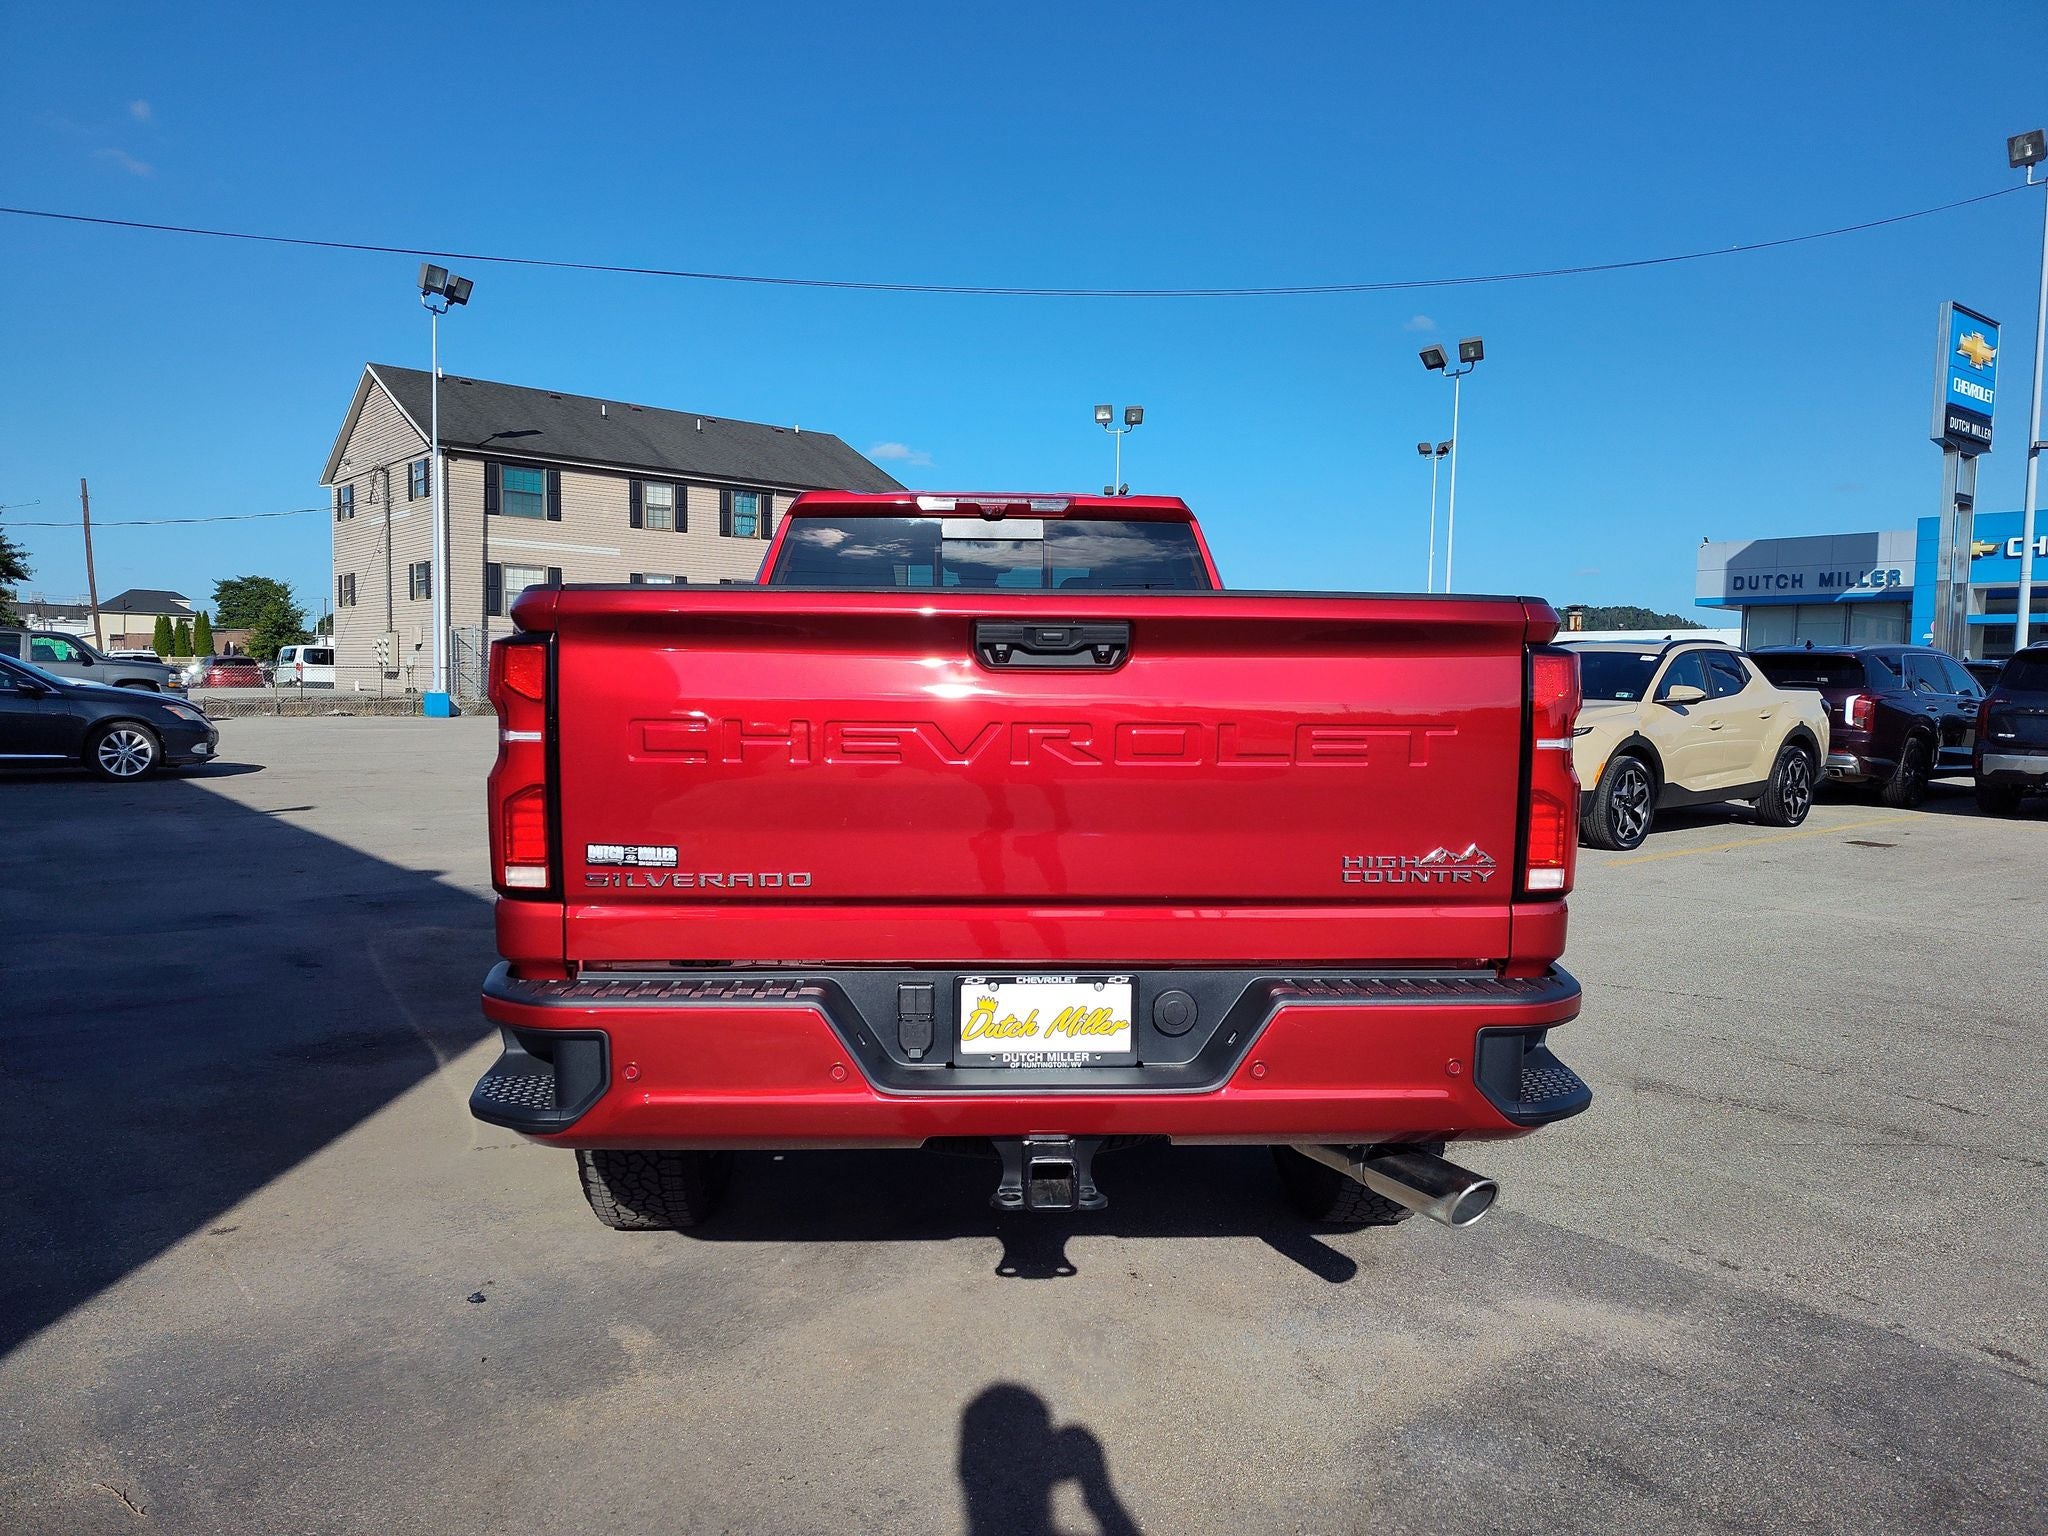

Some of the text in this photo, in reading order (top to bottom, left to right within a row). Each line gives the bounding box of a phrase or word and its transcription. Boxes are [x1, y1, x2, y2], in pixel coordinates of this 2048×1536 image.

[1953, 377, 1995, 404] CHEVROLET
[1950, 416, 1992, 441] DUTCH MILLER
[2006, 535, 2048, 557] CH
[1733, 568, 1903, 591] DUTCH MILLER
[627, 717, 1460, 768] CHEVROLET
[1343, 855, 1420, 868] HIGH
[585, 872, 812, 888] SILVERADO
[1342, 869, 1495, 883] COUNTRY
[1016, 976, 1078, 984] CHEVROLET
[961, 1005, 1129, 1041] Dutch Miller
[1002, 1052, 1090, 1063] DUTCH MILLER
